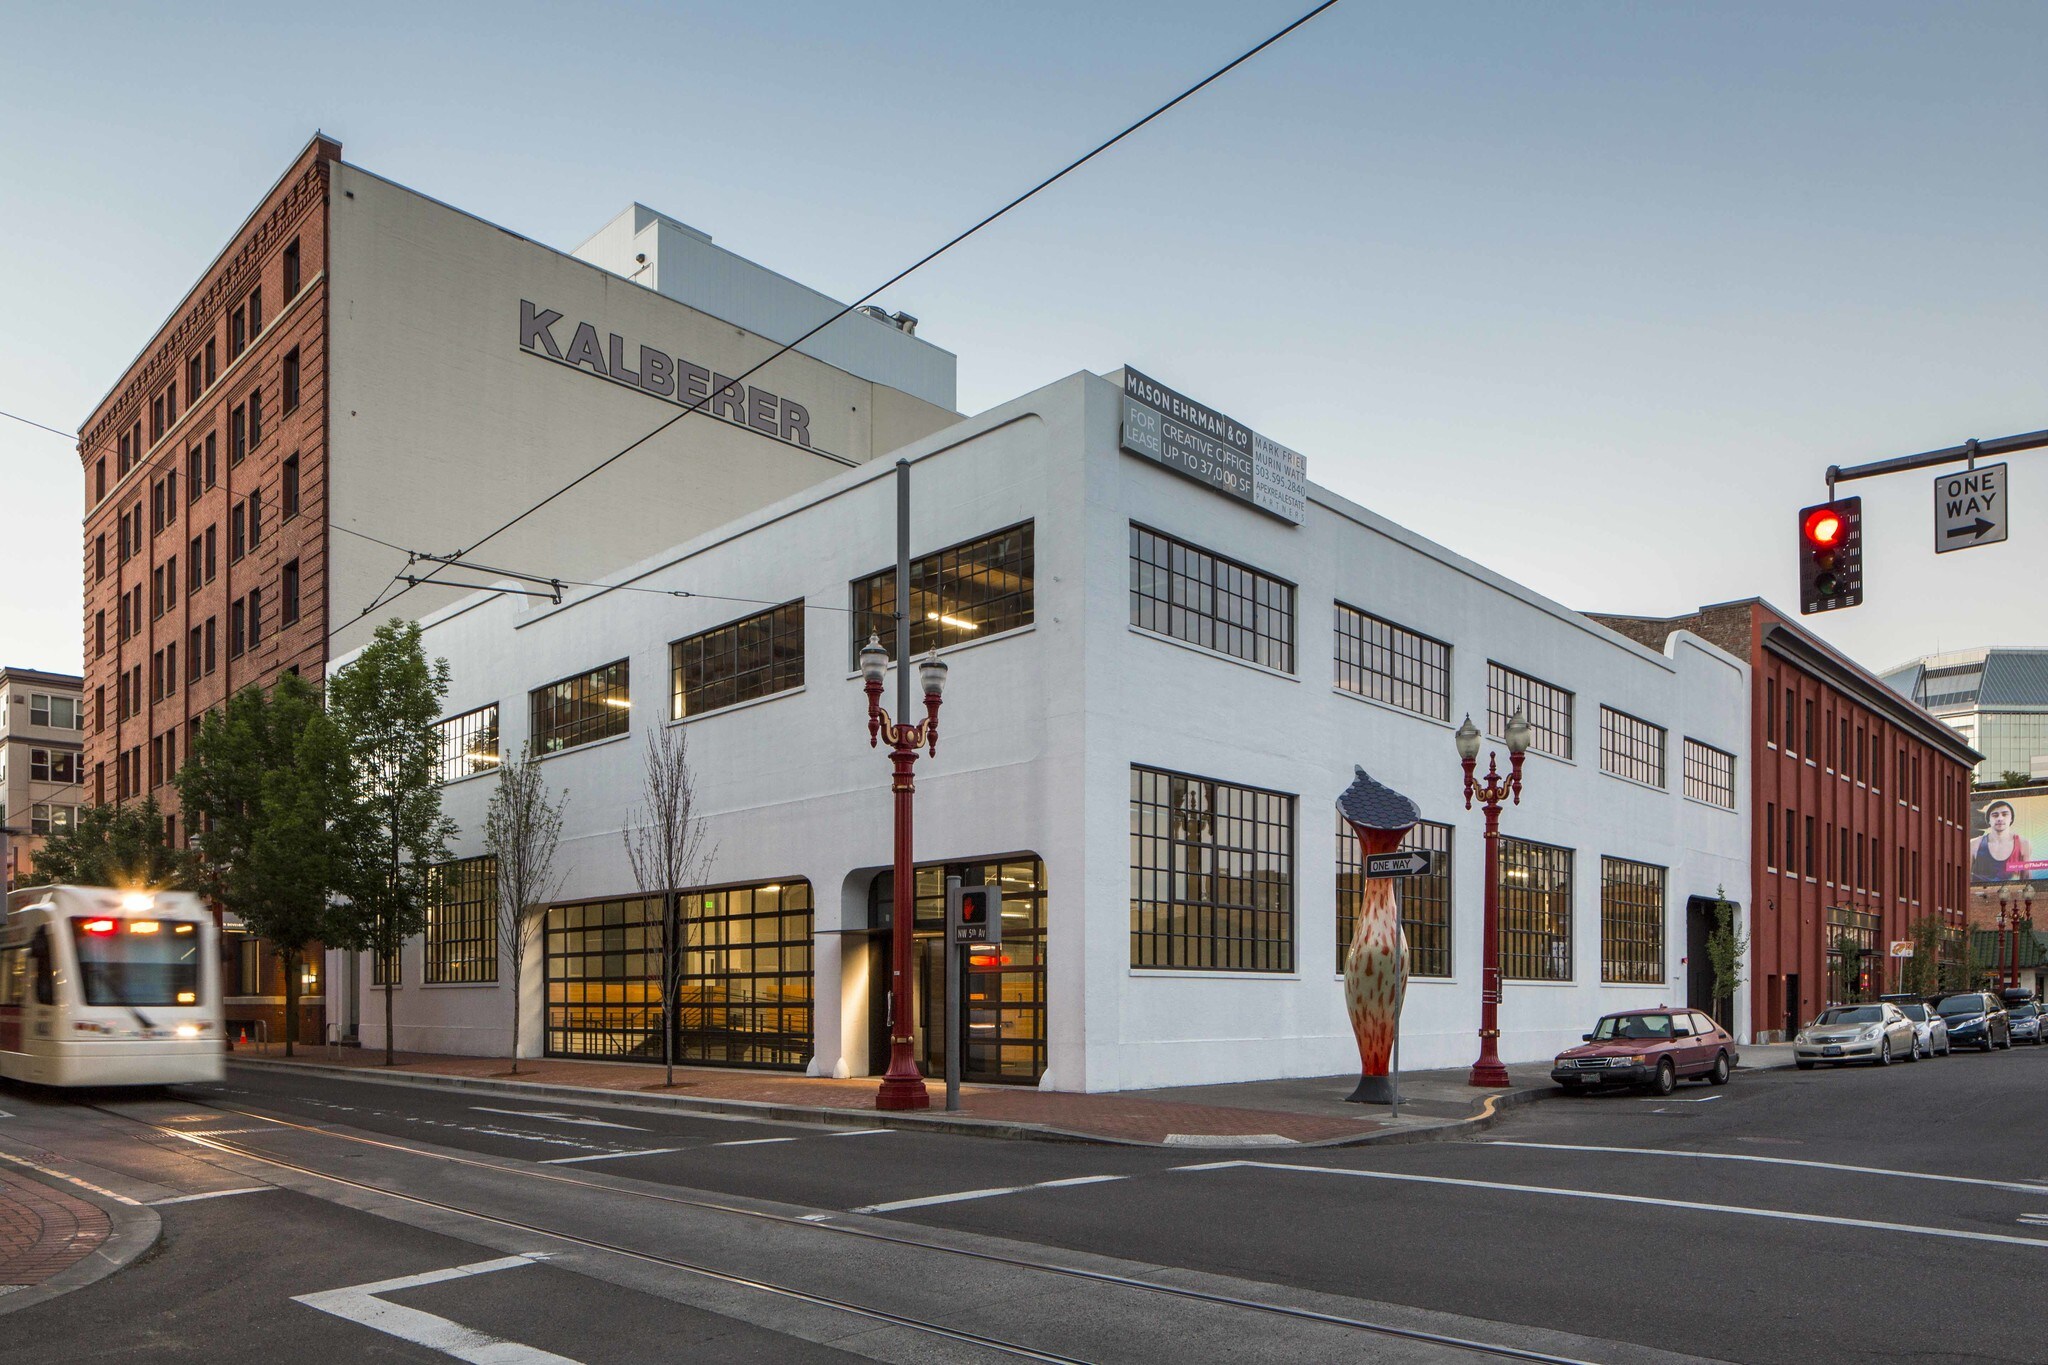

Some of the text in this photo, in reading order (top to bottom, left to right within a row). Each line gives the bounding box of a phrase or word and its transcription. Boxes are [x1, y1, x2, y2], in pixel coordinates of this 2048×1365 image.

[520, 298, 811, 448] KALBERER
[1127, 374, 1170, 411] MASON
[1173, 398, 1227, 436] EHRMAN
[1228, 425, 1234, 440] &
[1130, 407, 1155, 433] FOR
[1126, 424, 1159, 453] LEASE
[1162, 423, 1251, 476] CREATIVE OFFICE
[1255, 436, 1305, 471] MARK FRIEL
[1163, 442, 1251, 494] UP TO 37,000 SF
[1255, 451, 1305, 484] MURIN WATT
[1255, 464, 1306, 498] 503.595.2840
[1948, 472, 1995, 497] ONE
[1255, 493, 1305, 522] PARTNERS
[1946, 492, 1997, 518] WAY
[1372, 859, 1411, 871] ONE WAY
[958, 928, 985, 938] NW 5th Av
